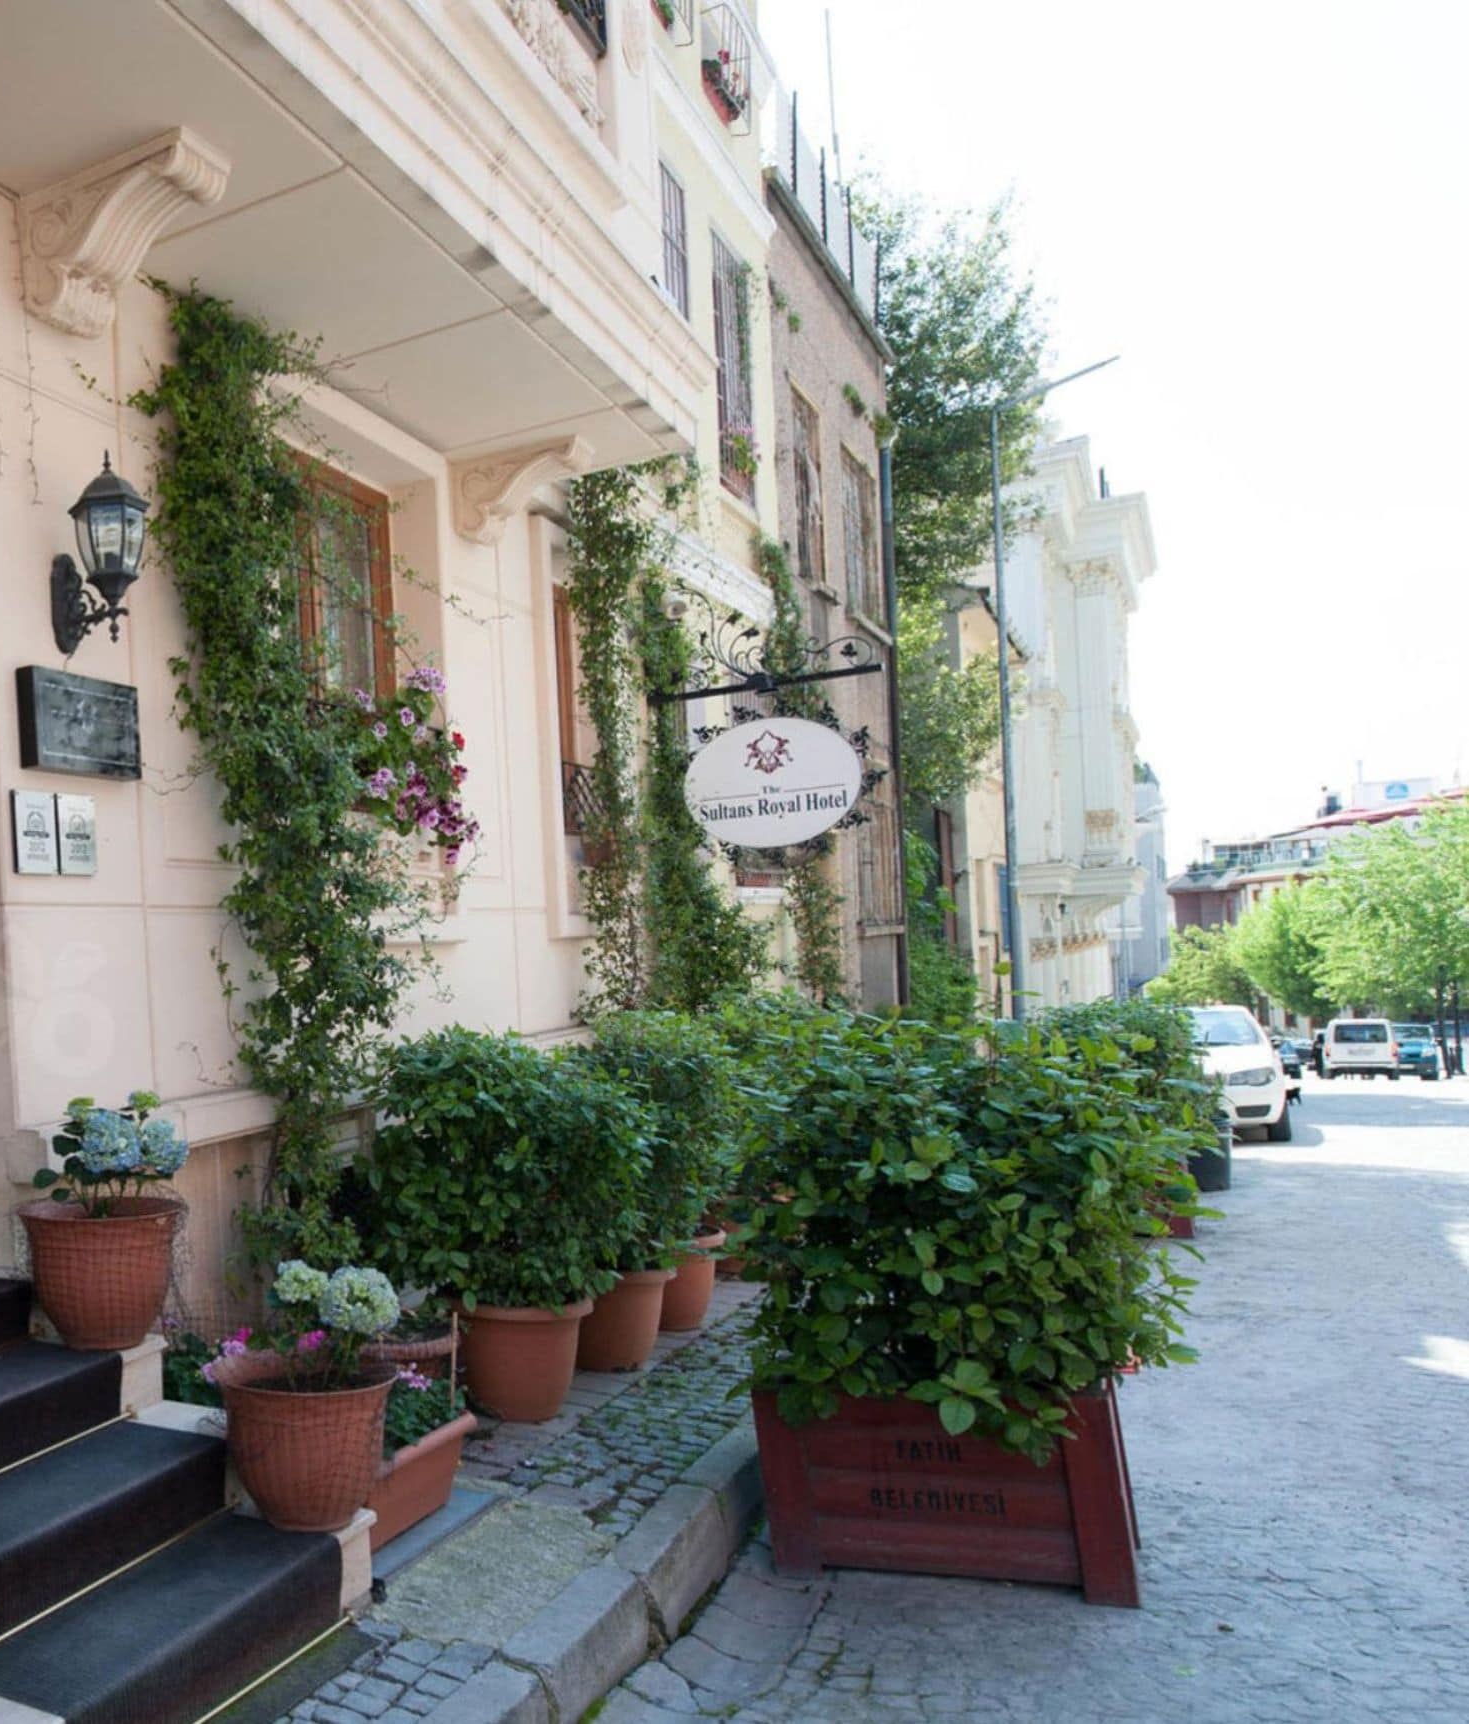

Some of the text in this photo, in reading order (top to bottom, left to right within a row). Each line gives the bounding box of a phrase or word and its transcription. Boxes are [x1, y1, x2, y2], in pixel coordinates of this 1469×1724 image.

[762, 786, 780, 794] The
[699, 789, 848, 822] Sultans Royal Hotel
